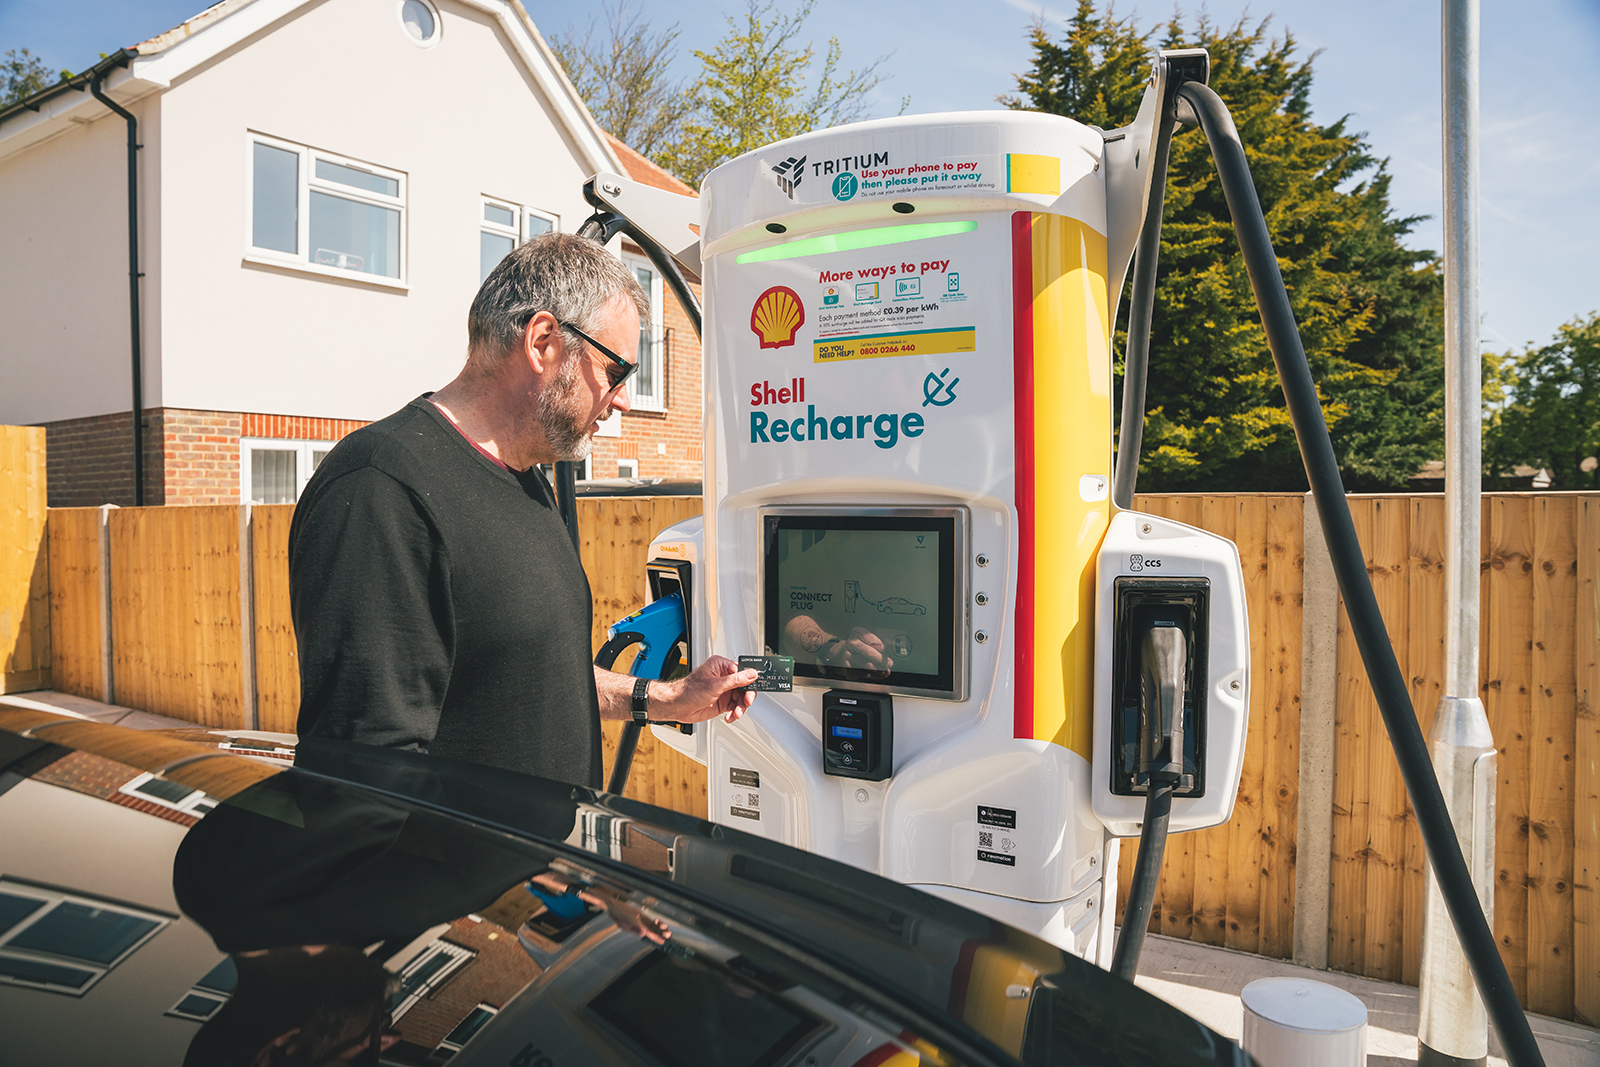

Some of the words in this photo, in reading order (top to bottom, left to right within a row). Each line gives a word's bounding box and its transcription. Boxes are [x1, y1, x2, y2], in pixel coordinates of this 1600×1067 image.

[812, 151, 889, 176] TRITIUM
[862, 170, 879, 178] Use
[882, 166, 905, 178] your
[908, 163, 940, 175] phone
[957, 162, 978, 172] pay
[861, 180, 882, 189] then
[885, 176, 918, 188] please
[921, 174, 938, 185] put
[942, 173, 948, 182] it
[951, 173, 982, 182] away
[819, 270, 853, 283] More
[857, 265, 896, 279] ways
[901, 261, 916, 274] to
[920, 260, 950, 275] pay
[834, 312, 858, 321] payment
[860, 308, 881, 317] method
[884, 306, 904, 315] £0.39
[906, 306, 919, 314] per
[921, 303, 939, 312] kWh
[880, 346, 899, 354] 0266
[750, 377, 804, 406] Shell
[750, 405, 924, 449] Recharge
[790, 592, 832, 602] CONNECT
[791, 601, 813, 610] PLUG
